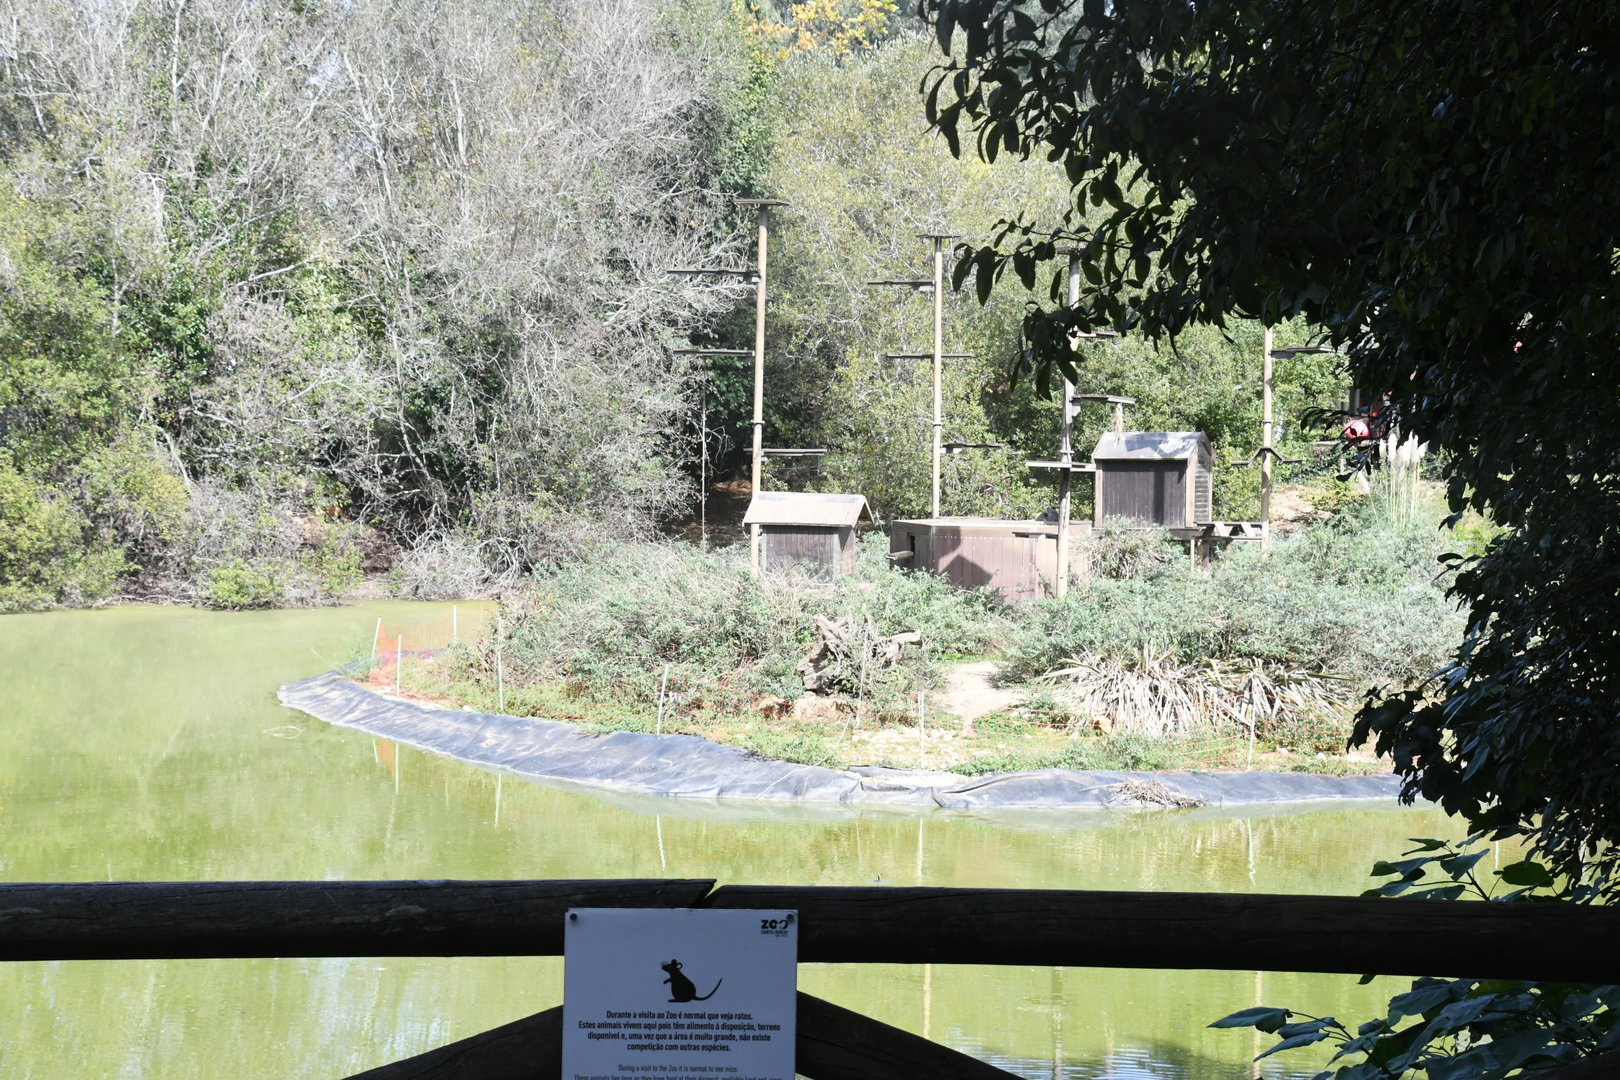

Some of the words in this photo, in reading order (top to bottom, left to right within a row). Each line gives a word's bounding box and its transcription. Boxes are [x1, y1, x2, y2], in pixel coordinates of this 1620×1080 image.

[606, 1010, 631, 1018] Durante
[720, 1012, 733, 1021] veja
[643, 1022, 656, 1030] aqui
[658, 1022, 671, 1030] pois
[721, 1023, 756, 1031] disposição,
[714, 1033, 738, 1041] grande,
[627, 1043, 663, 1051] competição
[702, 1043, 731, 1052] espécies.
[618, 1064, 635, 1072] During
